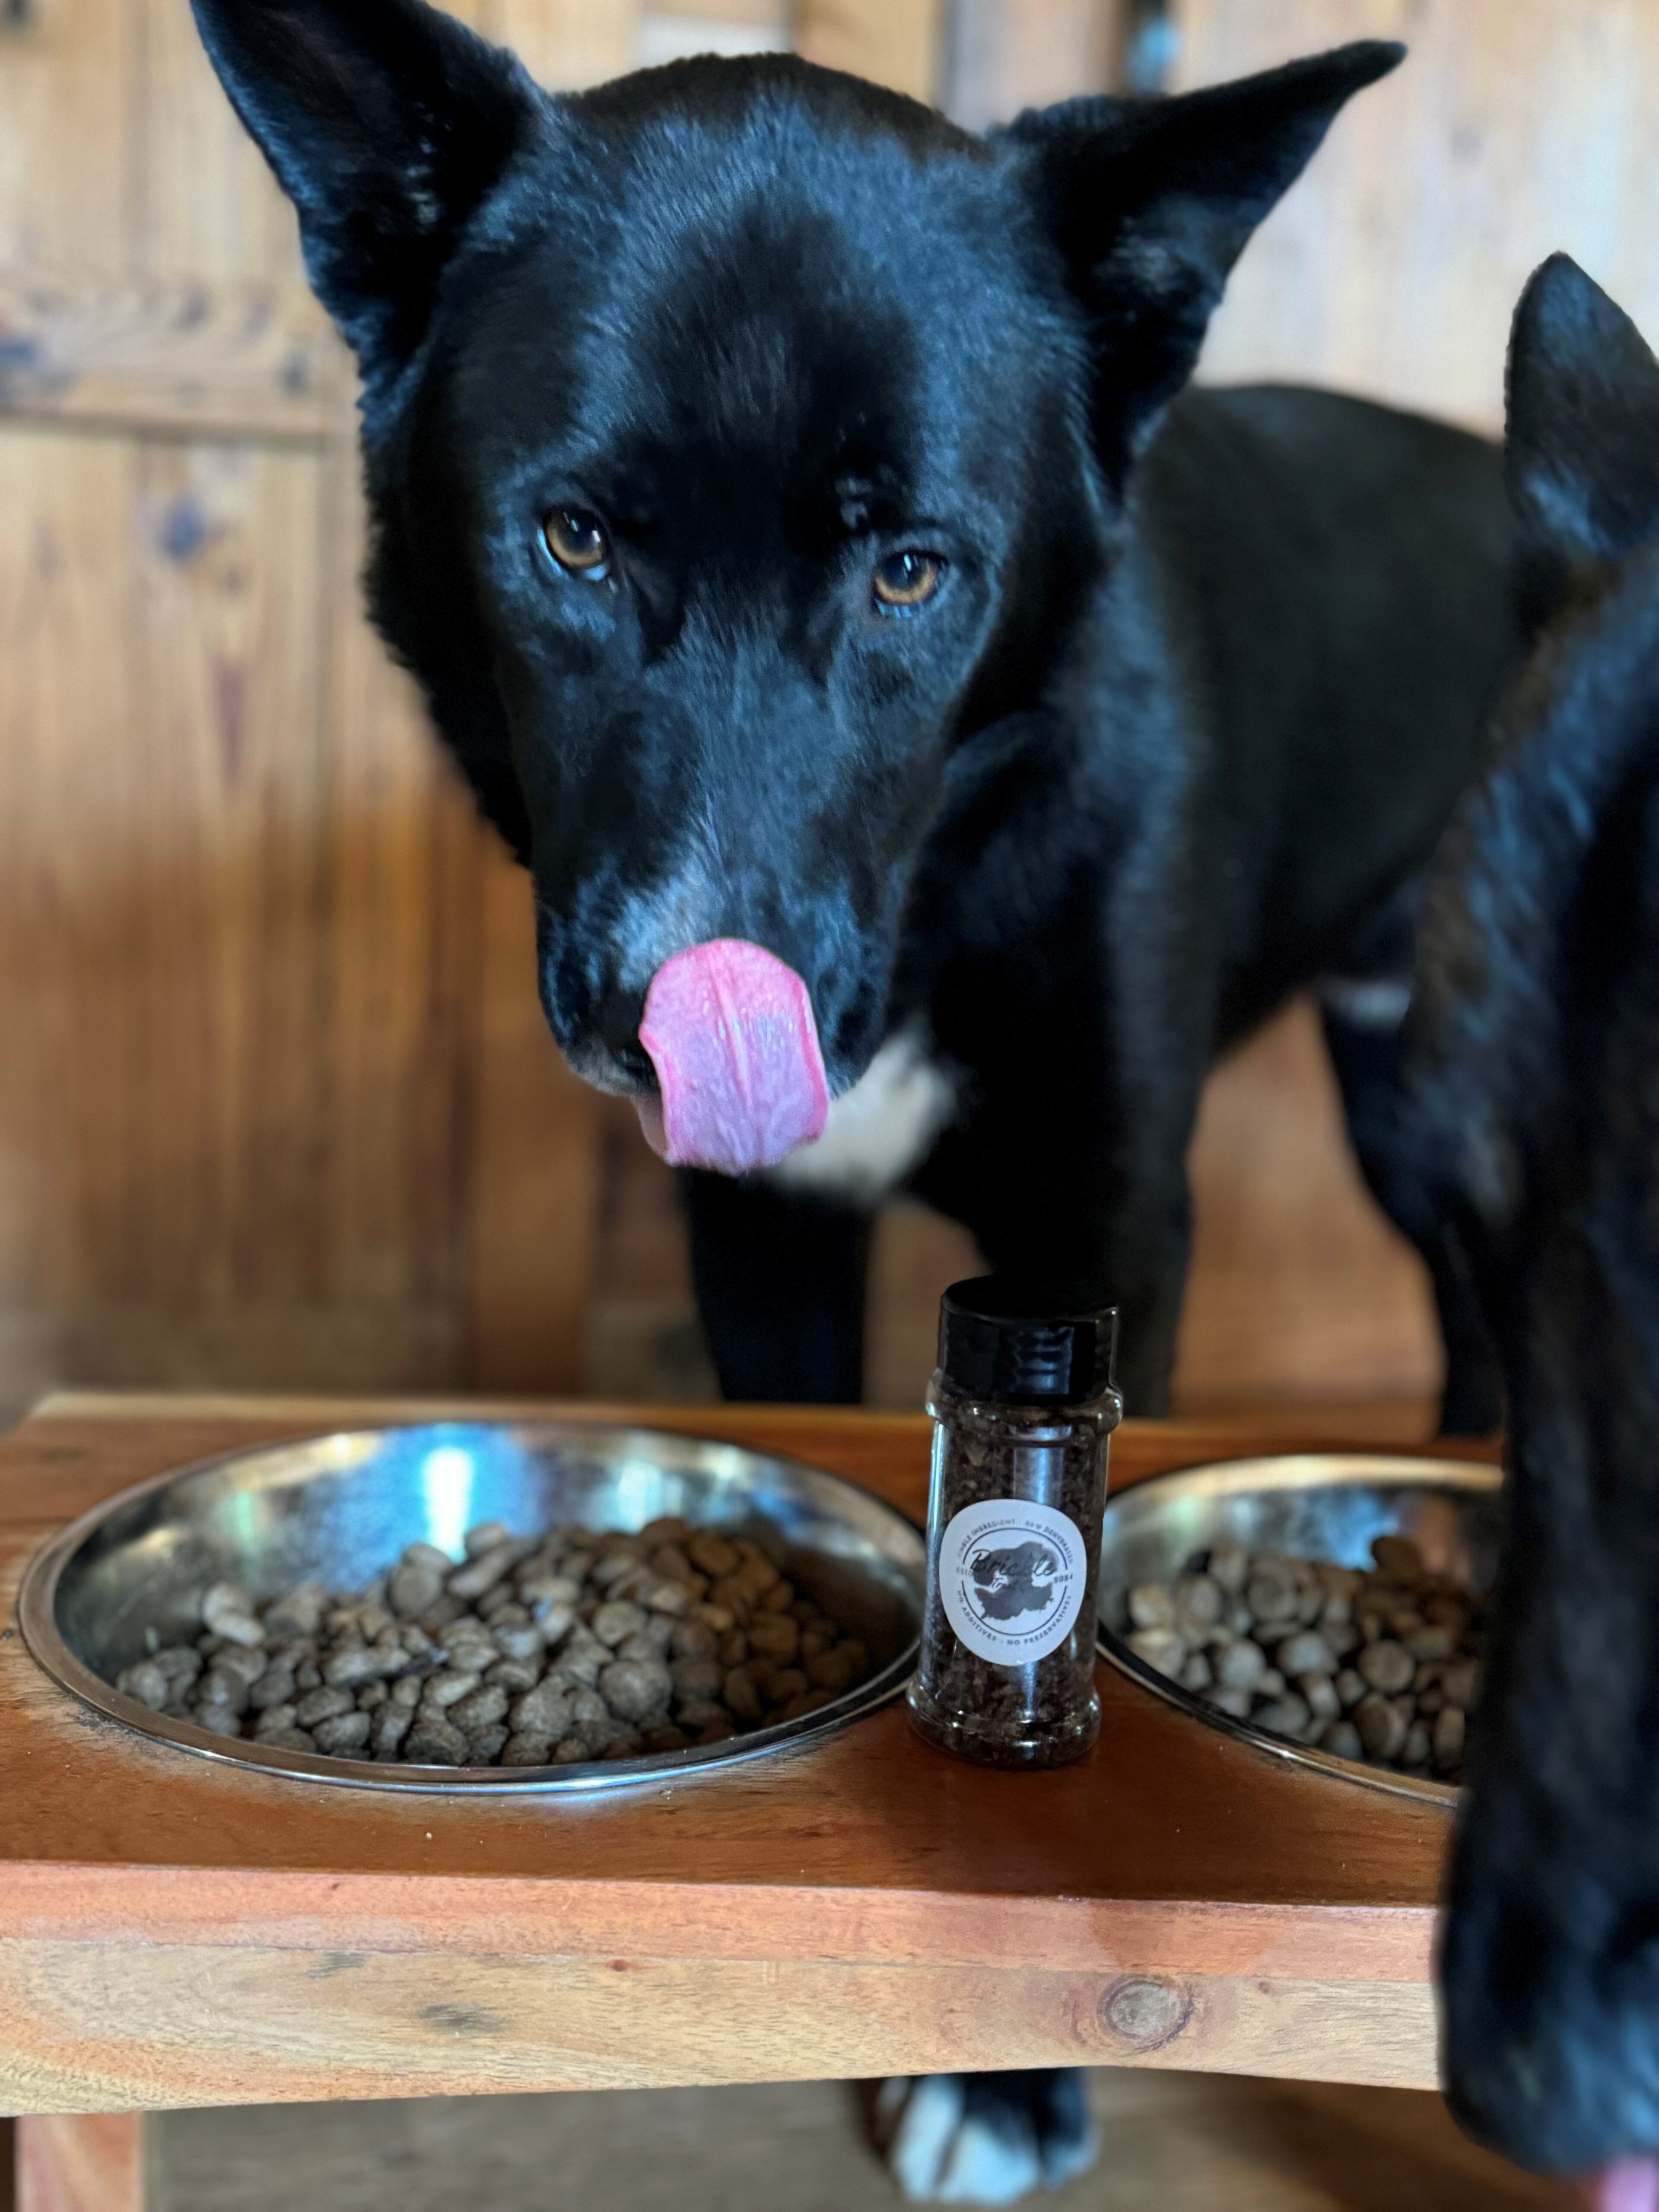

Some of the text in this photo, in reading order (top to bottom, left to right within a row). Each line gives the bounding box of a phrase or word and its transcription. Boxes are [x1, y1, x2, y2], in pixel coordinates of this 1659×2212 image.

[957, 1535, 971, 1557] NGLE
[962, 1606, 996, 1641] ADDITIVES
[1024, 1595, 1071, 1644] PRESERVATIVES
